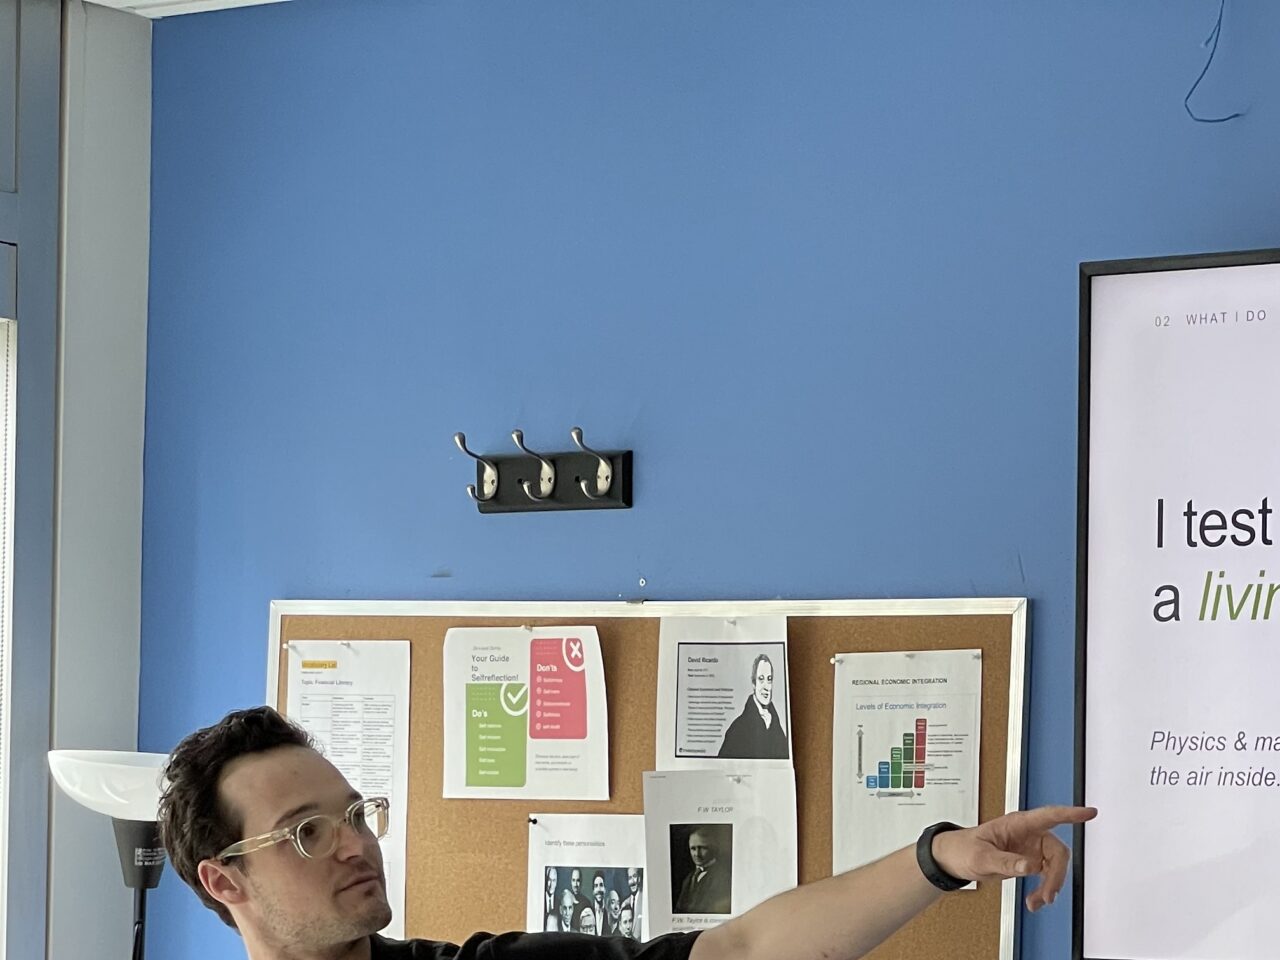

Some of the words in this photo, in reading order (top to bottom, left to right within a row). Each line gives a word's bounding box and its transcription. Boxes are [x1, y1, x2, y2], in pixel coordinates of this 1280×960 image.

[1154, 315, 1170, 327] 02
[1186, 311, 1227, 325] WHAT
[1246, 309, 1267, 321] DO
[1156, 498, 1164, 548] I
[1183, 497, 1273, 548] test
[1152, 584, 1181, 622] a
[489, 654, 510, 662] Guide
[885, 702, 914, 710] Economic
[916, 702, 947, 711] Integration
[1150, 730, 1227, 756] Physics
[1233, 732, 1248, 752] &
[1150, 766, 1180, 786] the
[1186, 766, 1213, 786] air
[1217, 766, 1280, 787] inside.
